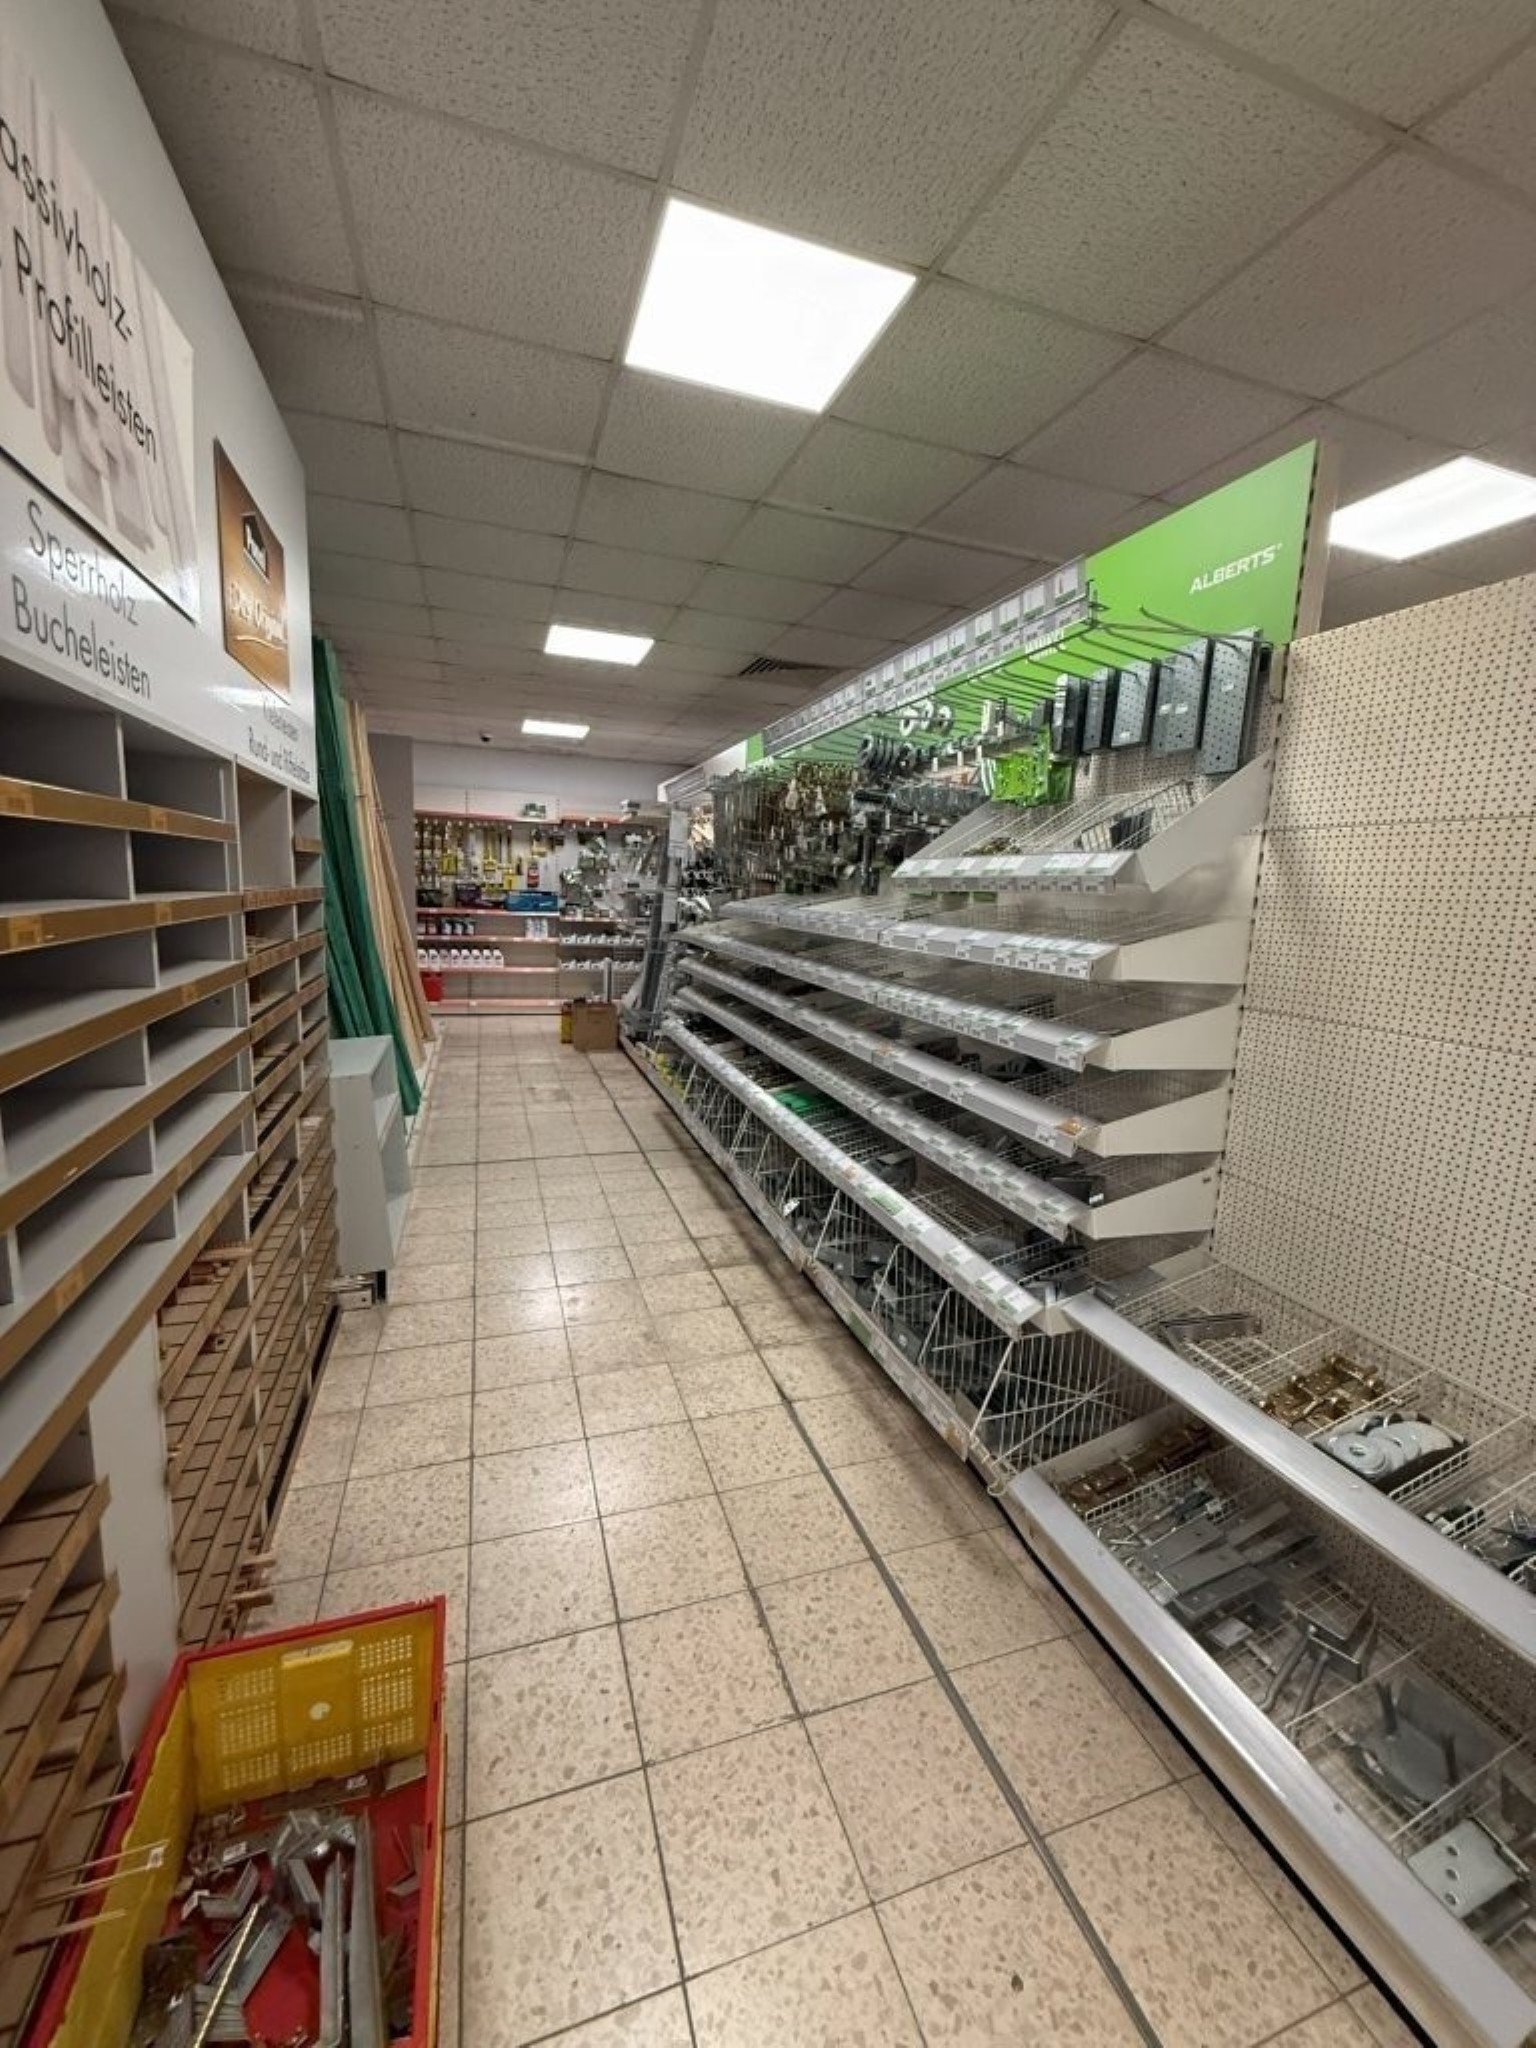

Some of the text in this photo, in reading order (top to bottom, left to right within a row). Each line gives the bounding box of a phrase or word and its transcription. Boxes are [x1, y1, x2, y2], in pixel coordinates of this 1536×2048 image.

[13, 226, 157, 463] Profilleisten
[27, 499, 139, 626] Sperrholz
[12, 573, 151, 699] Bucheleisten
